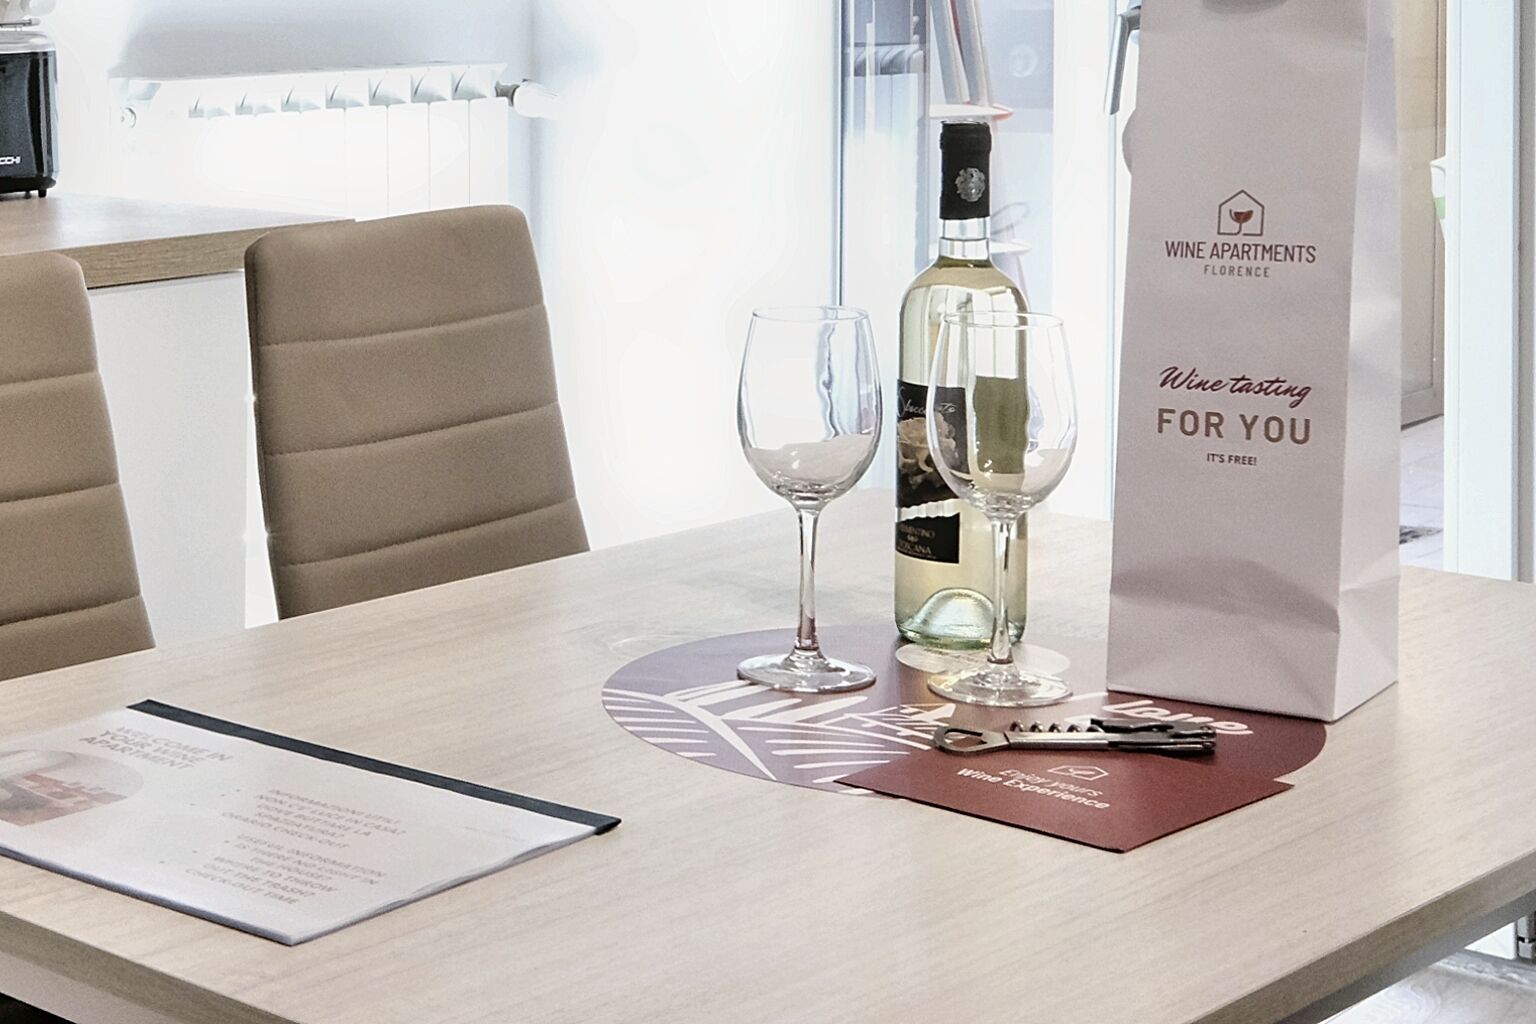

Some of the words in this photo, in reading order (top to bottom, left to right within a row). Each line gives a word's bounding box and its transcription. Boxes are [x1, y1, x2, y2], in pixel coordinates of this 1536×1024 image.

[1165, 240, 1207, 260] WINE
[1209, 242, 1317, 264] APARTMENTS
[1203, 264, 1271, 279] FLORENCE
[1159, 366, 1229, 393] Wine
[1229, 374, 1312, 409] tasting
[1157, 407, 1225, 439] FOR
[1238, 413, 1311, 446] YOU
[1207, 452, 1225, 465] IT'S
[1228, 453, 1257, 467] FREE!
[76, 736, 197, 769] APARTMENT
[957, 767, 1003, 784] Wine
[1002, 778, 1111, 810] Experience
[1050, 779, 1104, 798] yours
